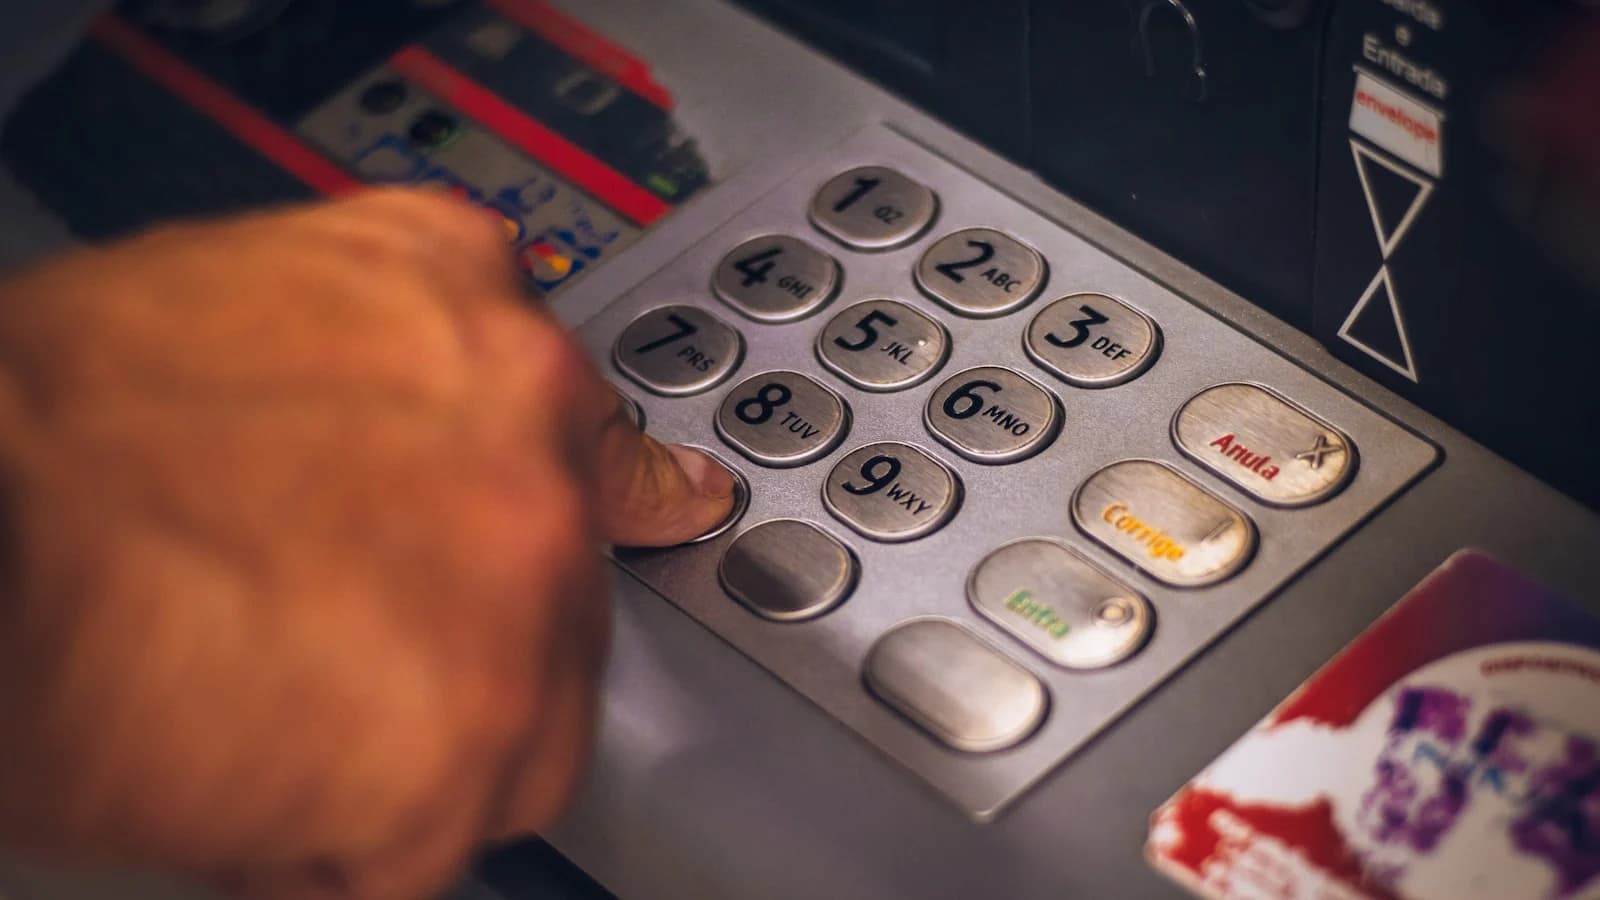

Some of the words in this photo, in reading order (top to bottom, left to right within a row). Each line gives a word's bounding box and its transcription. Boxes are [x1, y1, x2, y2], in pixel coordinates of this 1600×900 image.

[1362, 32, 1448, 99] Entrada
[1355, 91, 1439, 144] envelope
[833, 177, 879, 214] 1
[735, 247, 782, 288] 4
[777, 275, 815, 301] GHI
[936, 240, 995, 284] 2
[984, 267, 1022, 293] ABC
[632, 313, 698, 354] 7
[676, 345, 716, 373] PRS
[833, 309, 899, 351] 5
[880, 341, 914, 365] JKL
[1044, 305, 1110, 349] 3
[1091, 335, 1132, 362] DEF
[734, 383, 793, 425] 8
[779, 411, 821, 441] TUV
[943, 380, 1003, 419] 6
[985, 405, 1031, 437] MNO
[841, 454, 901, 496] 9
[886, 481, 932, 515] WXY
[1209, 433, 1281, 482] Anula
[1102, 503, 1185, 562] Corrige
[1005, 590, 1071, 640] Entra
